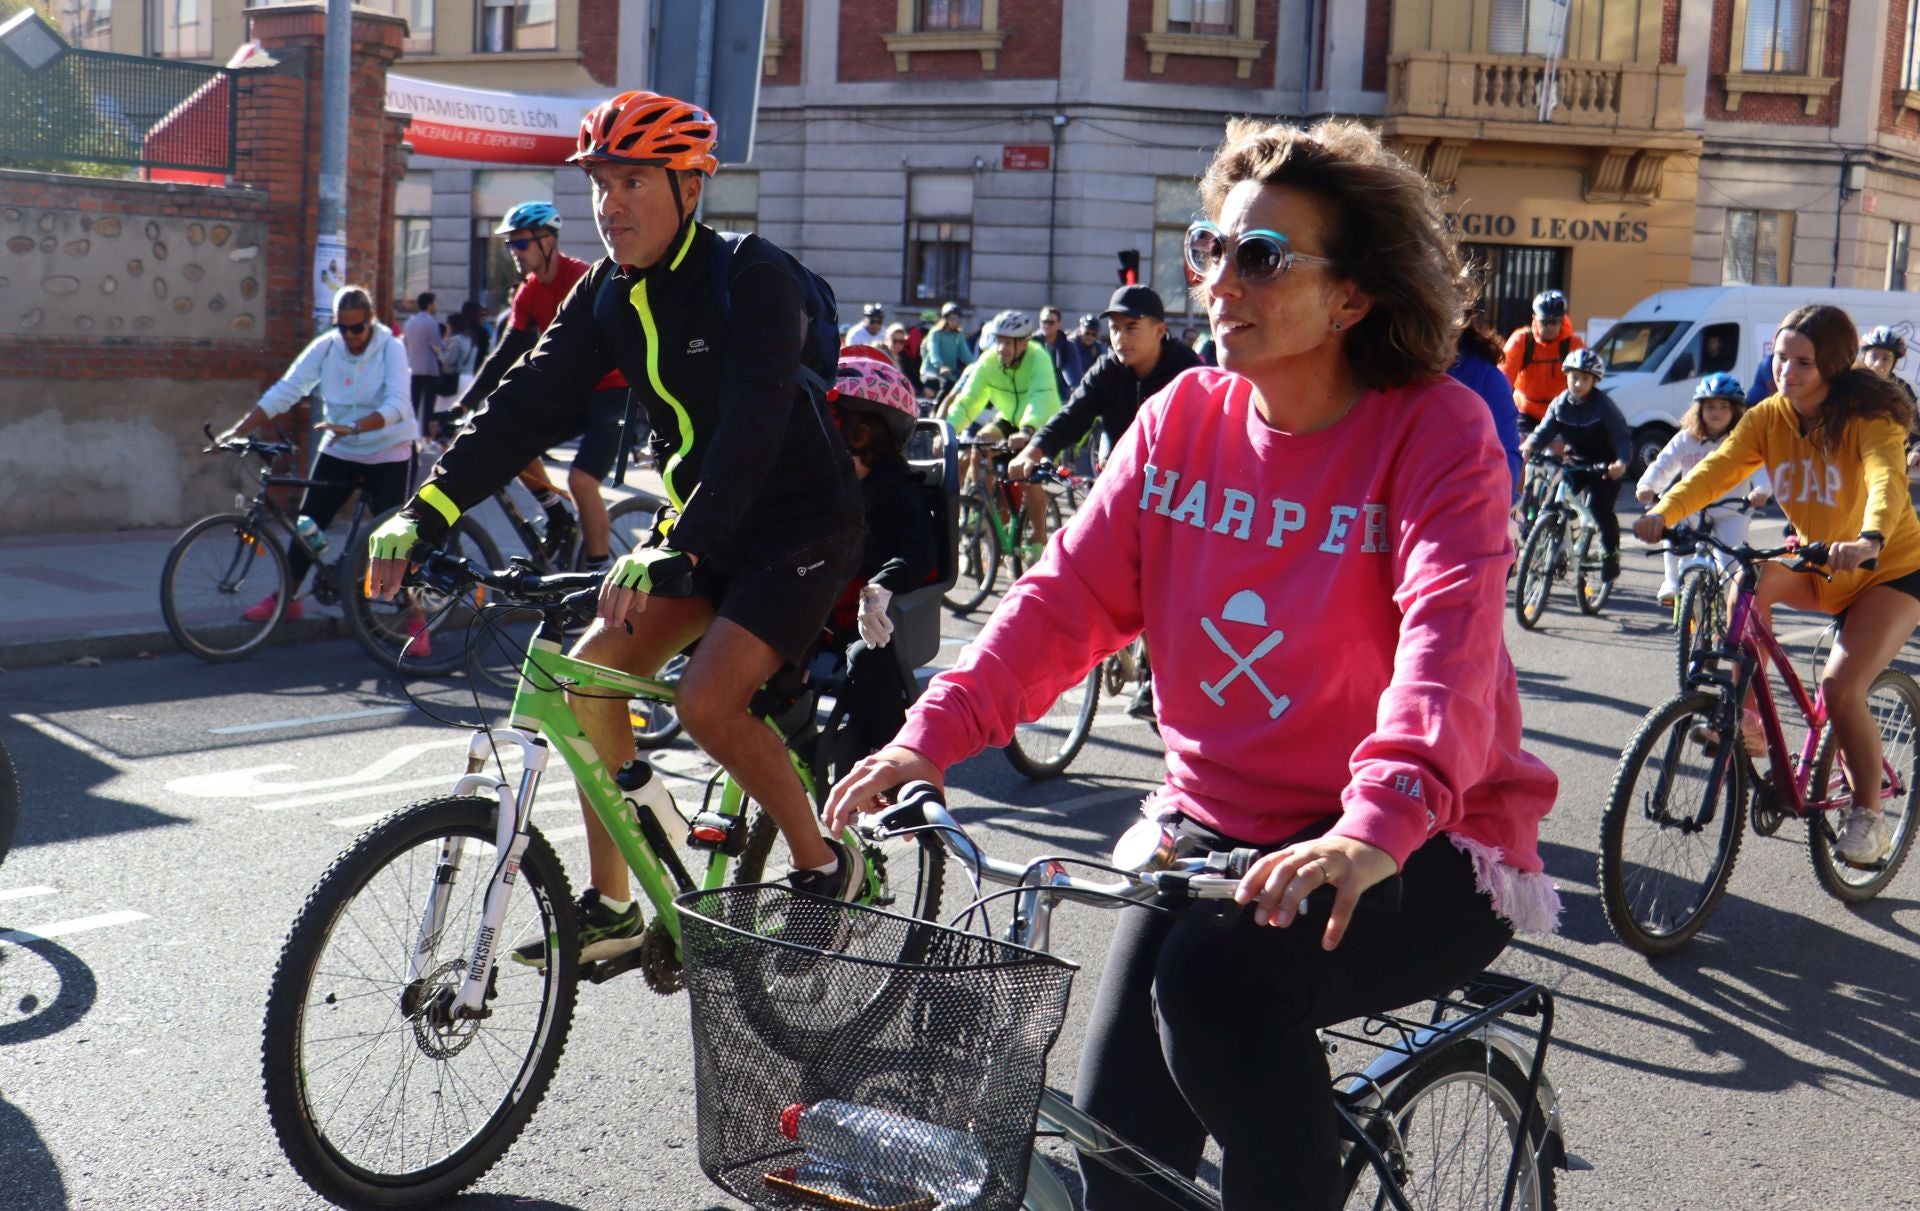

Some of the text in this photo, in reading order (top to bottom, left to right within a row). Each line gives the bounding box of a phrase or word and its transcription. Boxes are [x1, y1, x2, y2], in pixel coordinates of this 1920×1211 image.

[386, 92, 559, 129] YUNTAMIENTO DE LEÓN
[403, 123, 536, 149] ONCEJALÍA DE DEPORTES
[1444, 211, 1648, 243] EGIO LEONÉS
[1773, 459, 1842, 506] GAP
[1138, 463, 1391, 555] HARPER
[469, 925, 496, 982] ROCKSHOX
